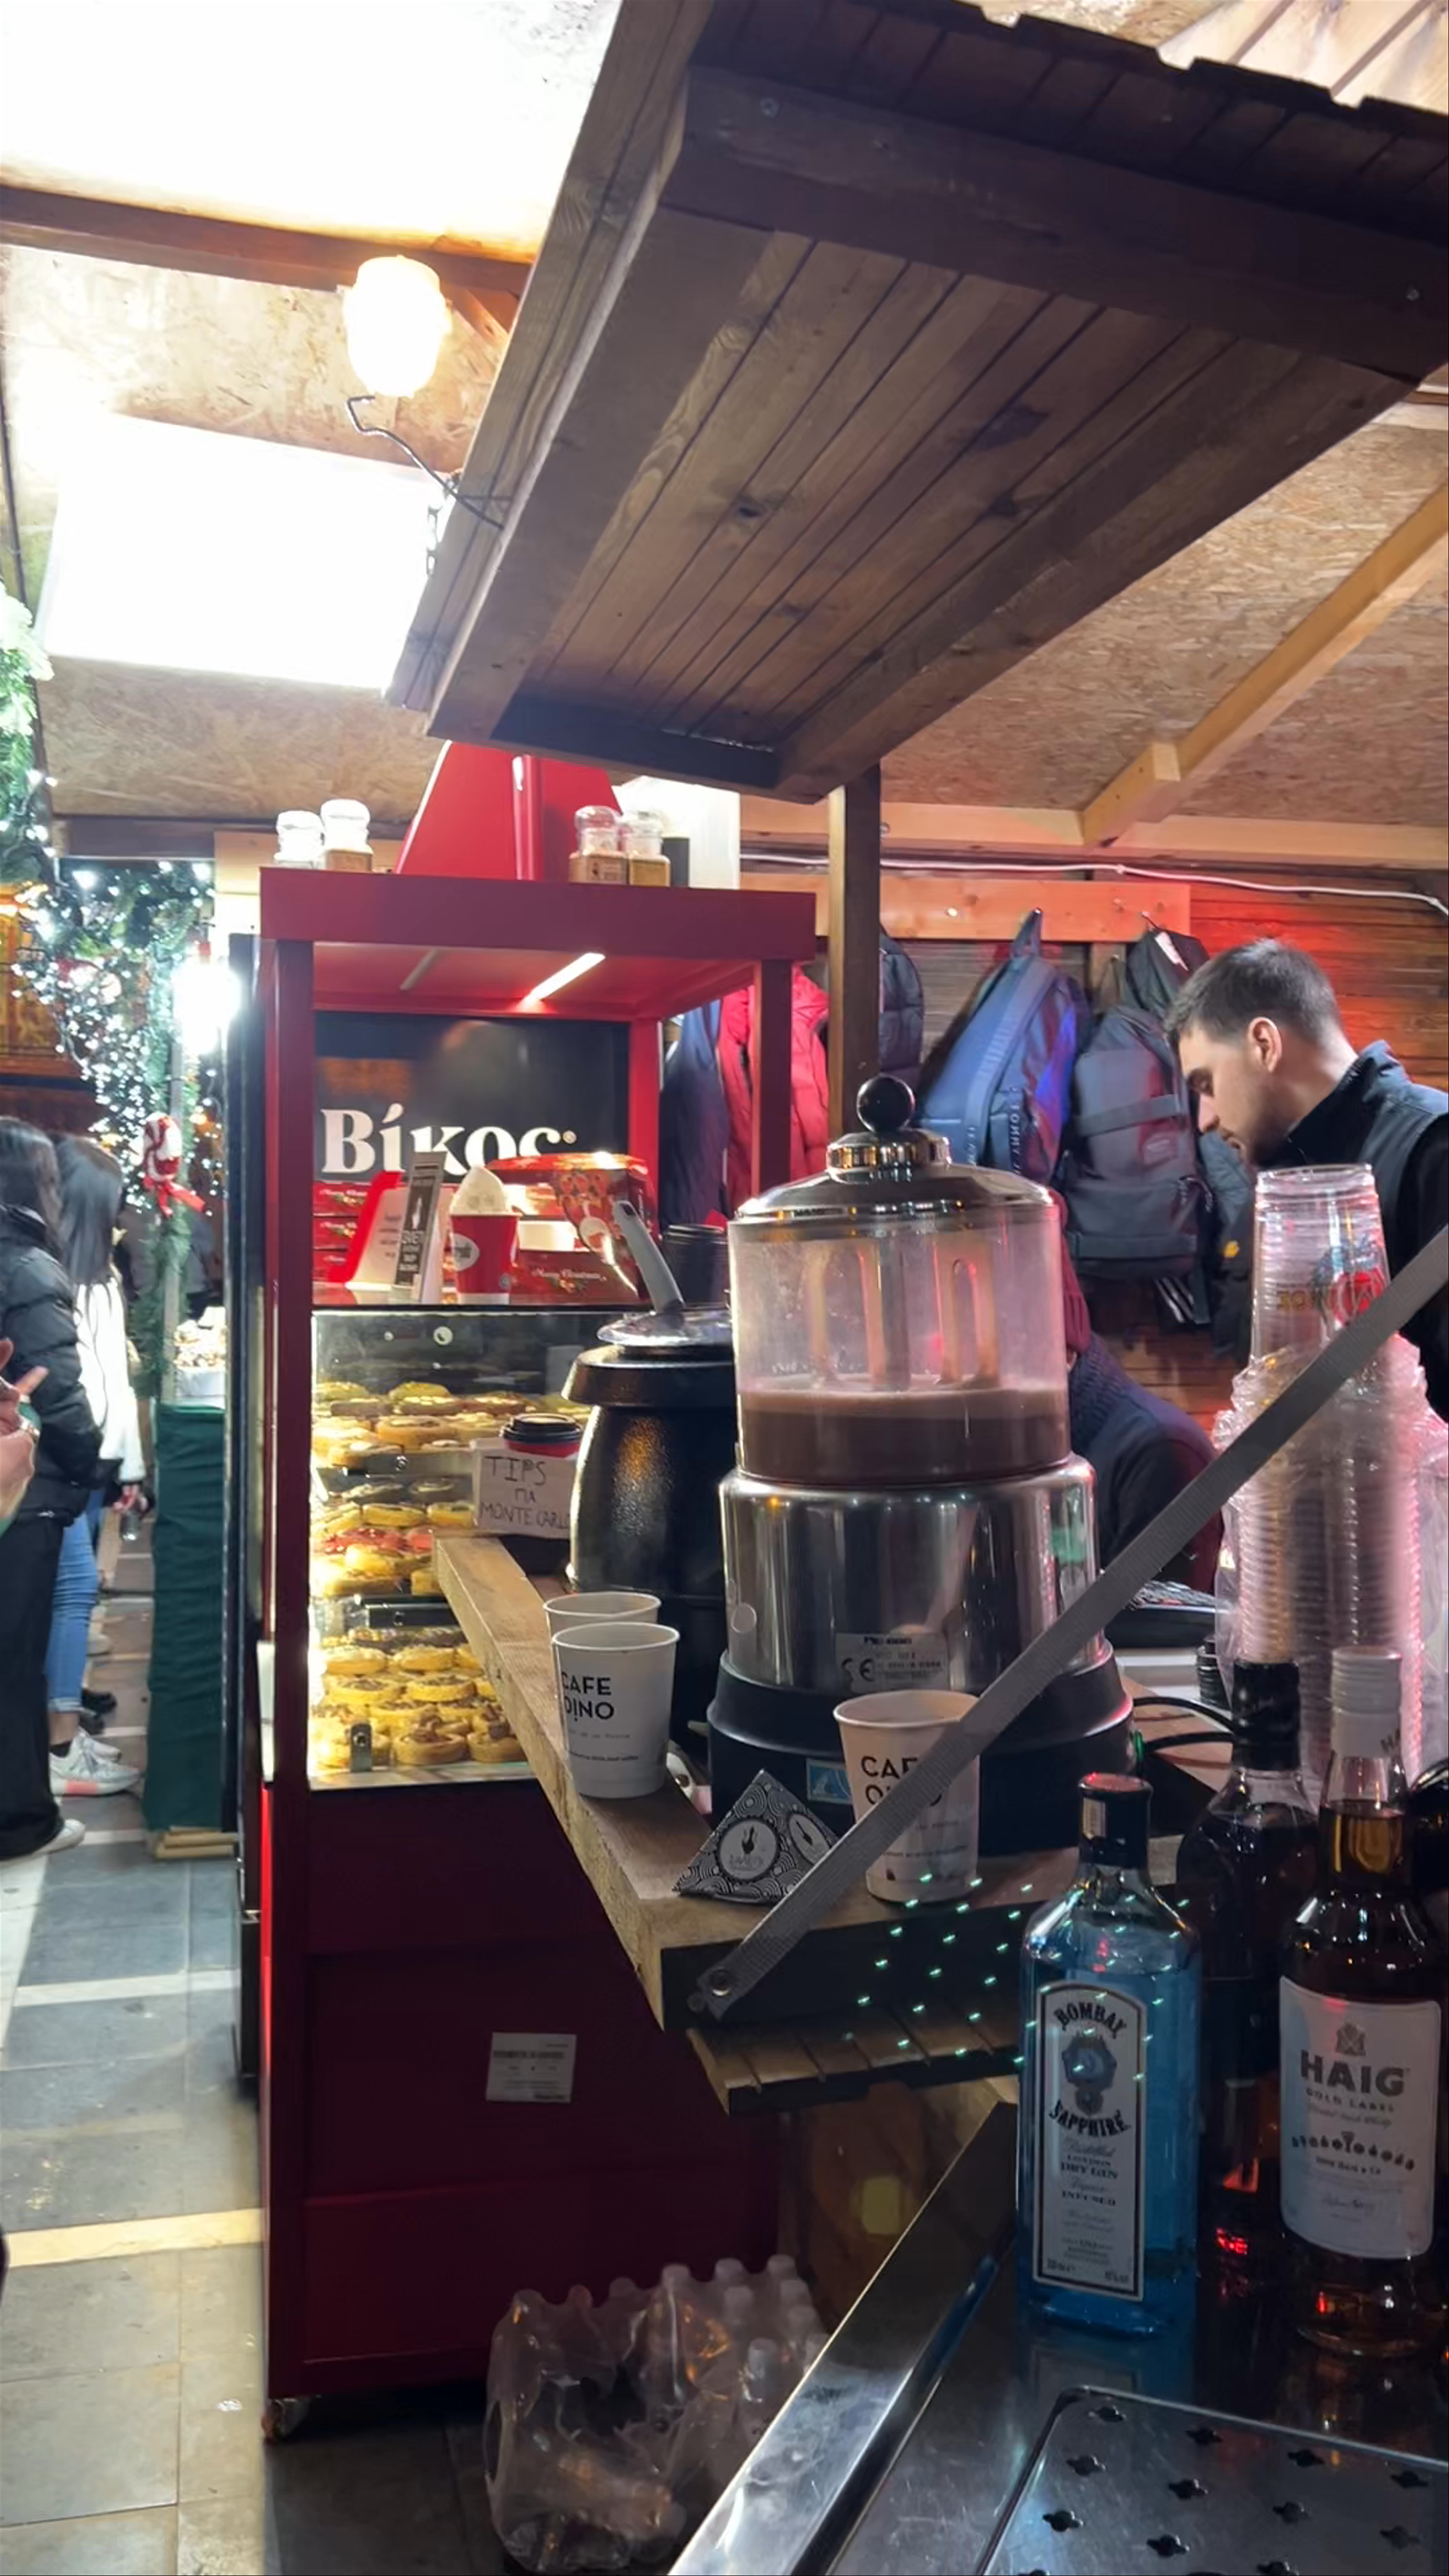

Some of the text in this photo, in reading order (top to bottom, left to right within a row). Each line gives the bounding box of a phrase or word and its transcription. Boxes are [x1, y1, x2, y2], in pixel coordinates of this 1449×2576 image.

[484, 1456, 546, 1486] TIPS
[480, 1502, 532, 1525] MONTE
[561, 1670, 612, 1696] CAFE
[861, 1755, 918, 1780] CAF
[1054, 2001, 1128, 2040] BOMBAY
[1300, 2049, 1405, 2098] HAIG
[1306, 2087, 1342, 2106] GOLD
[1349, 2098, 1395, 2113] LABEL
[1049, 2098, 1132, 2137] SAPPHIRE
